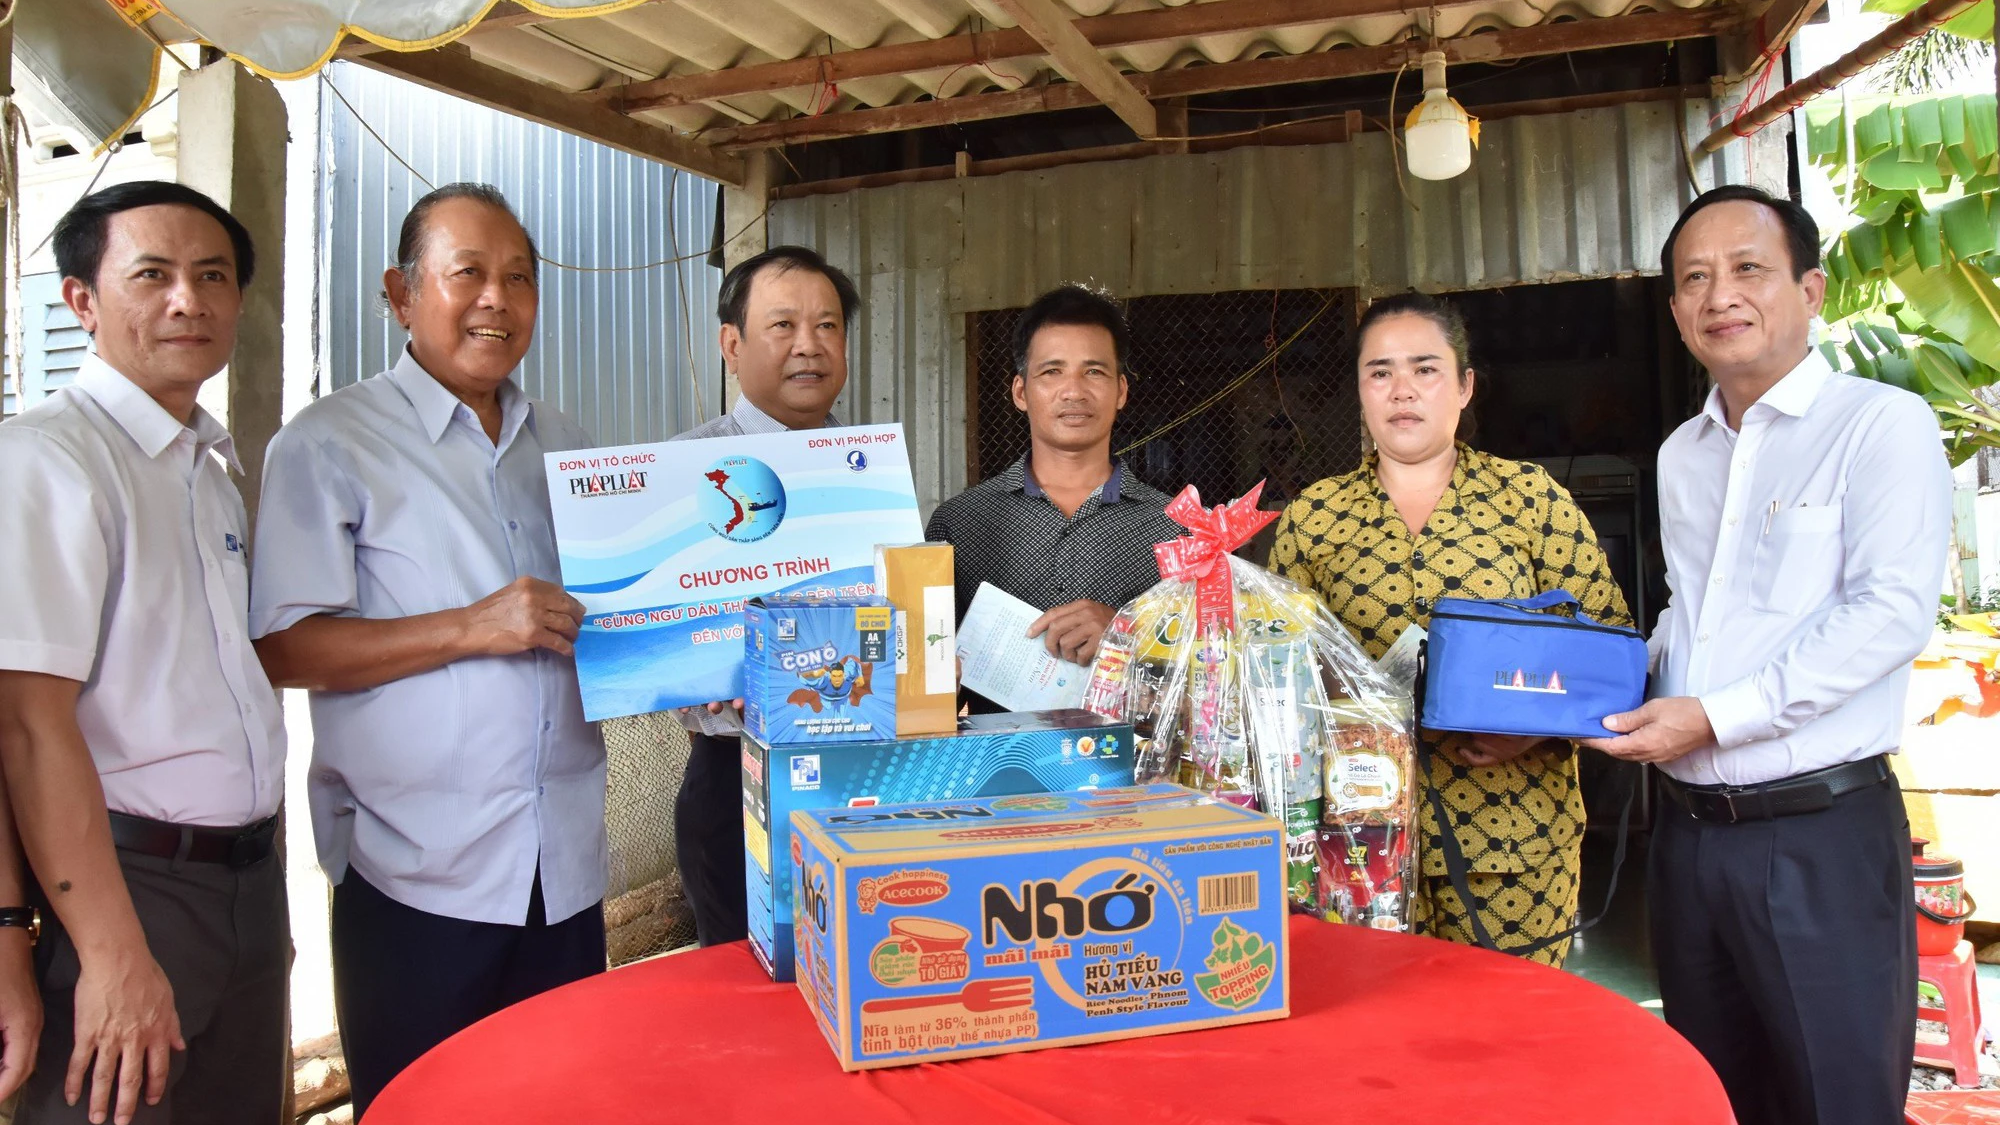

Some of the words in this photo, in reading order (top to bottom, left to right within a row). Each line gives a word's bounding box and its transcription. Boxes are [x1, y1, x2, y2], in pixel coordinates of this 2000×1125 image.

[808, 438, 832, 448] ĐƠN
[834, 437, 846, 448] VỊ
[874, 433, 897, 444] HỢP
[559, 460, 586, 471] ĐƠN
[589, 459, 601, 470] VỊ
[622, 452, 656, 465] CHỨC
[1553, 528, 1574, 539] GUCCI
[1570, 542, 1578, 564] GUCCI
[679, 564, 769, 590] CHƯƠNG
[772, 557, 831, 578] TRÌNH
[1368, 572, 1387, 588] GUCCI
[1368, 591, 1389, 607] GUCCI
[649, 606, 685, 624] NGƯ
[687, 600, 720, 618] DÂN
[724, 624, 745, 641] VỚ
[867, 633, 879, 642] AA
[806, 725, 820, 735] học
[1348, 763, 1378, 773] Select
[1466, 775, 1487, 794] GUCCI
[1470, 802, 1488, 818] GUCCI
[1519, 803, 1539, 825] GUCCI
[1470, 821, 1490, 840] GUCCI
[1164, 844, 1176, 855] SẢN
[1208, 841, 1224, 851] CÔNG
[1225, 840, 1241, 850] NGHỆ
[1243, 838, 1258, 848] NHẬT
[877, 871, 900, 886] Cook
[902, 868, 948, 881] happiness
[1487, 885, 1505, 902] GUCCI
[984, 873, 1155, 945] Nhớ
[1486, 907, 1507, 924] GUCCI
[984, 949, 1025, 965] mãi
[1031, 944, 1070, 961] mãi
[1084, 944, 1118, 957] Hương
[1122, 941, 1132, 954] vị
[940, 962, 966, 979] GIẤY
[1085, 958, 1111, 980] HỦ
[1116, 954, 1159, 977] TIẾU
[1086, 979, 1126, 996] NAM
[1130, 972, 1183, 990] VANG
[1209, 965, 1269, 1000] TOPPING
[1086, 1000, 1107, 1008] Rice
[1108, 995, 1144, 1006] Noodles
[1150, 989, 1187, 1001] Phnom
[1233, 986, 1257, 1003] HƠN
[1086, 1008, 1114, 1018] Penh
[1116, 1005, 1144, 1015] Style
[1147, 998, 1189, 1010] Flavour
[864, 1025, 889, 1038] Nĩa
[894, 1024, 915, 1035] làm
[920, 1021, 932, 1032] từ
[936, 1016, 968, 1031] 36%
[974, 1015, 1005, 1027] thành
[1009, 1009, 1035, 1025] phần
[863, 1040, 892, 1053] tinh
[900, 1034, 923, 1051] bột
[927, 1034, 956, 1048] (thay
[961, 1028, 980, 1043] thế
[984, 1027, 1012, 1040] nhựa
[1016, 1024, 1037, 1038] PP)
